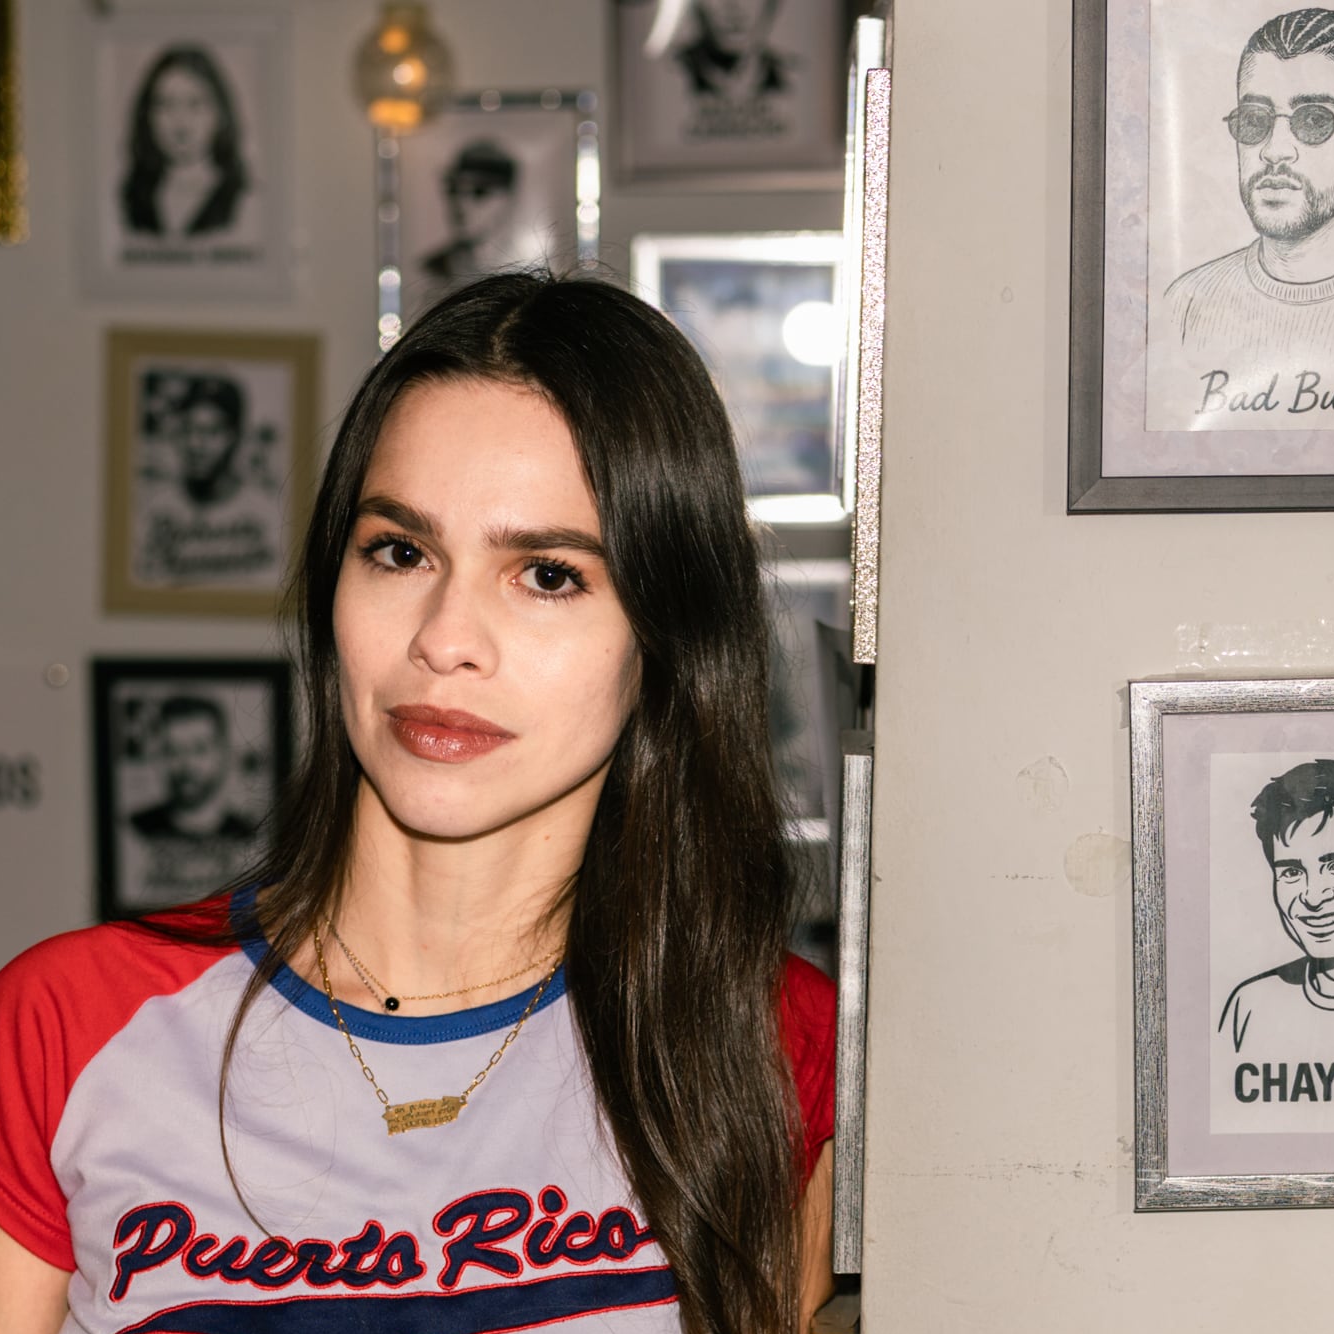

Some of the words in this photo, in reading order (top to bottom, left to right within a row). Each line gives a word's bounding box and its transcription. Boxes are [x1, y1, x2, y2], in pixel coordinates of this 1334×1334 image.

[1195, 370, 1280, 415] Bad
[109, 1200, 425, 1301] Puerto
[433, 1185, 657, 1290] Rico
